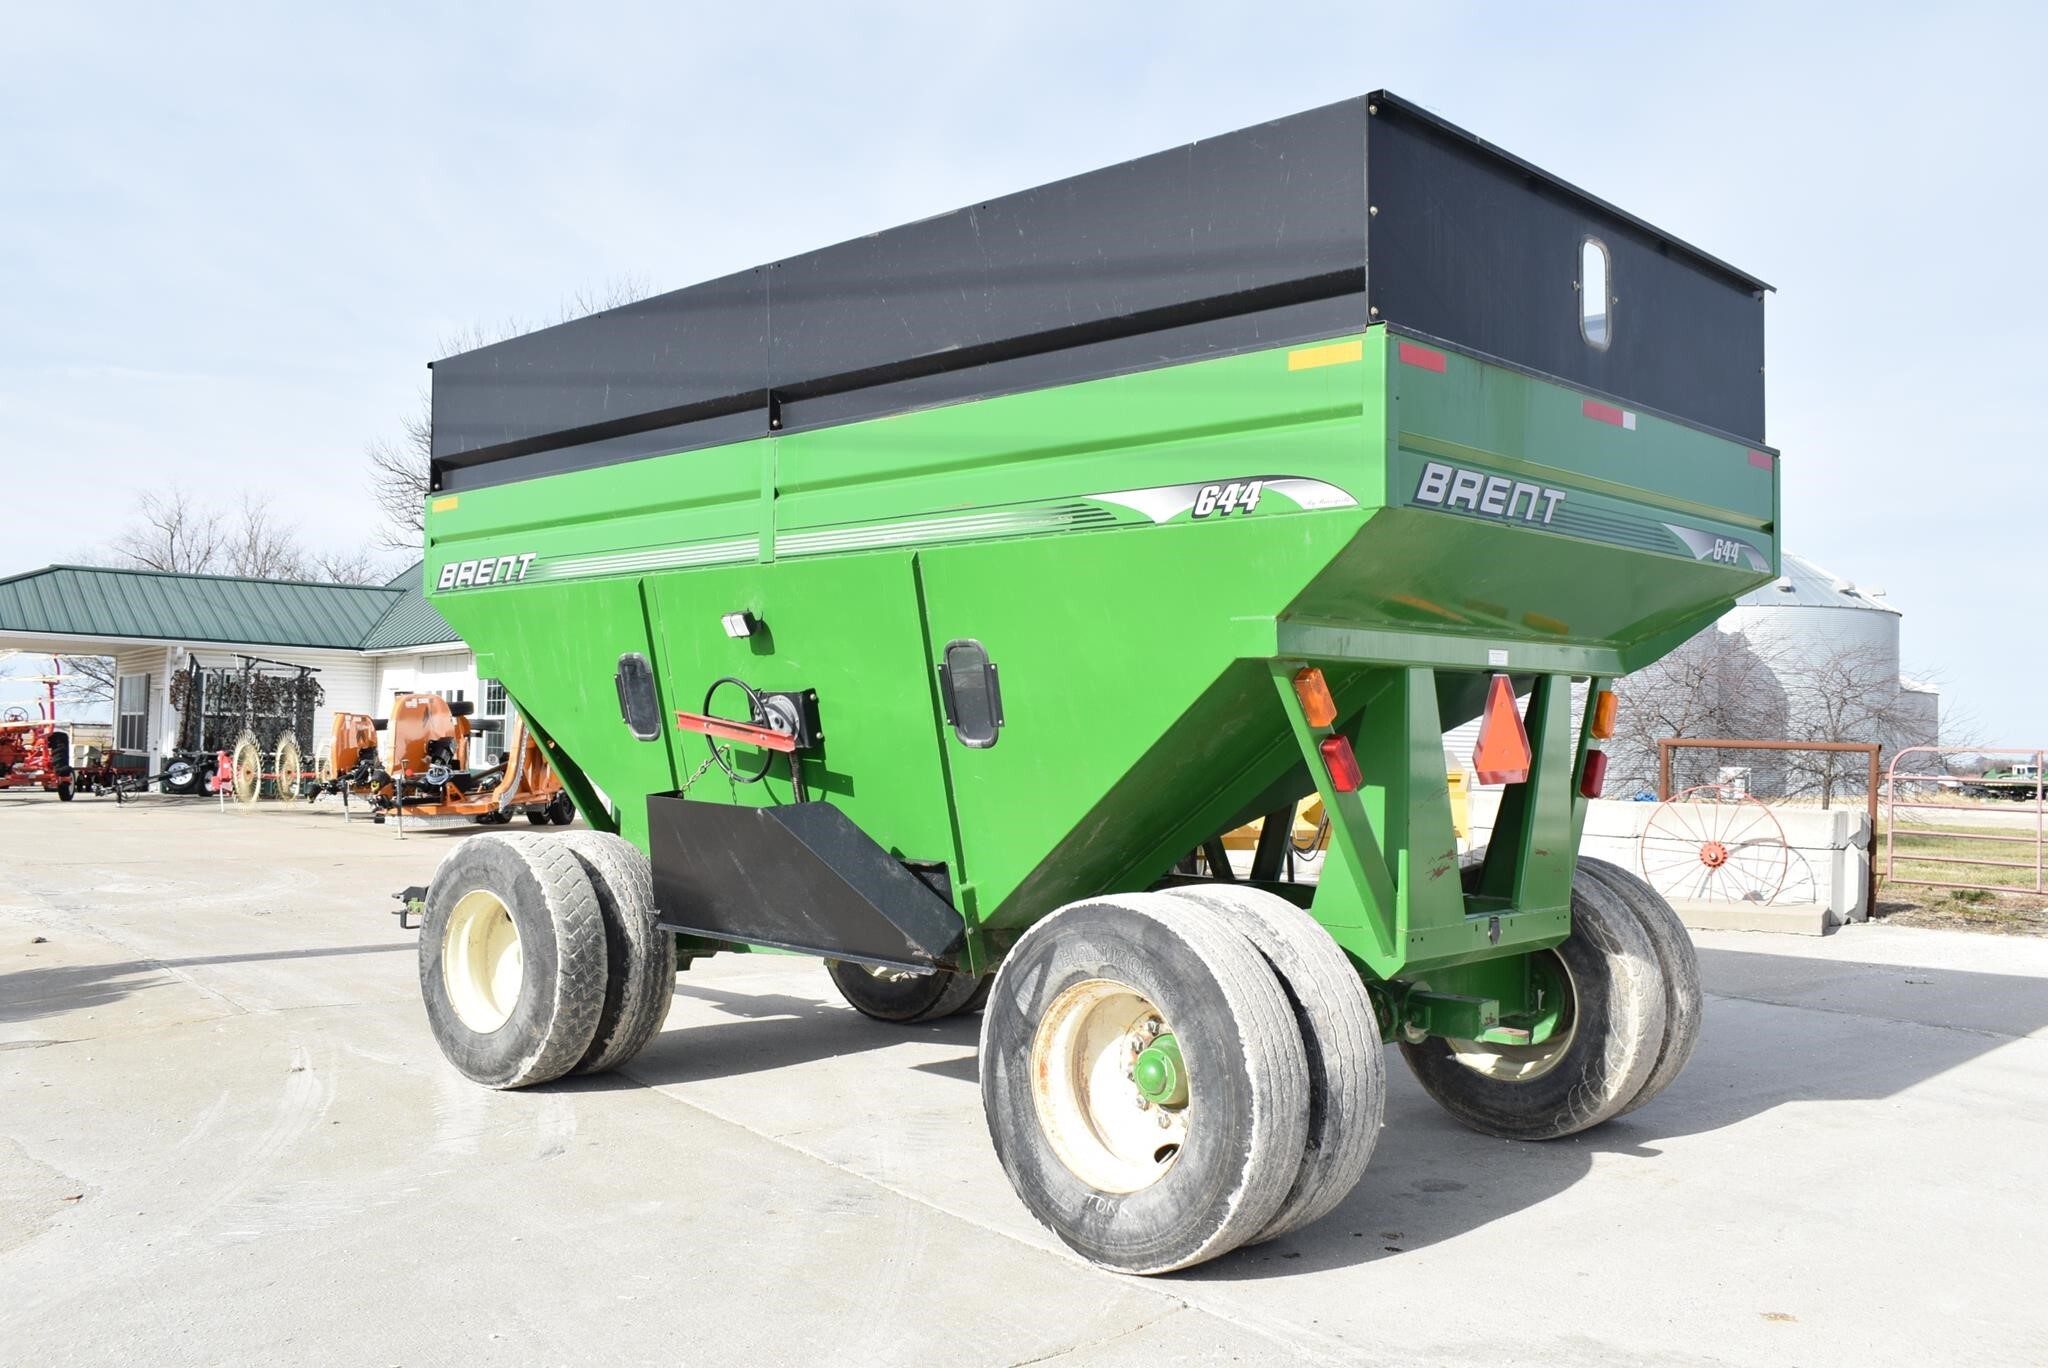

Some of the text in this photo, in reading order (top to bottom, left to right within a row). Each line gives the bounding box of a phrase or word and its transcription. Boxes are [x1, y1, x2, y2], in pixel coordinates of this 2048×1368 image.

[1192, 480, 1264, 519] 644
[1413, 461, 1567, 527] BRENT
[1712, 538, 1740, 564] 644
[437, 552, 537, 590] BRENT
[1060, 943, 1178, 1004] HANKOOK
